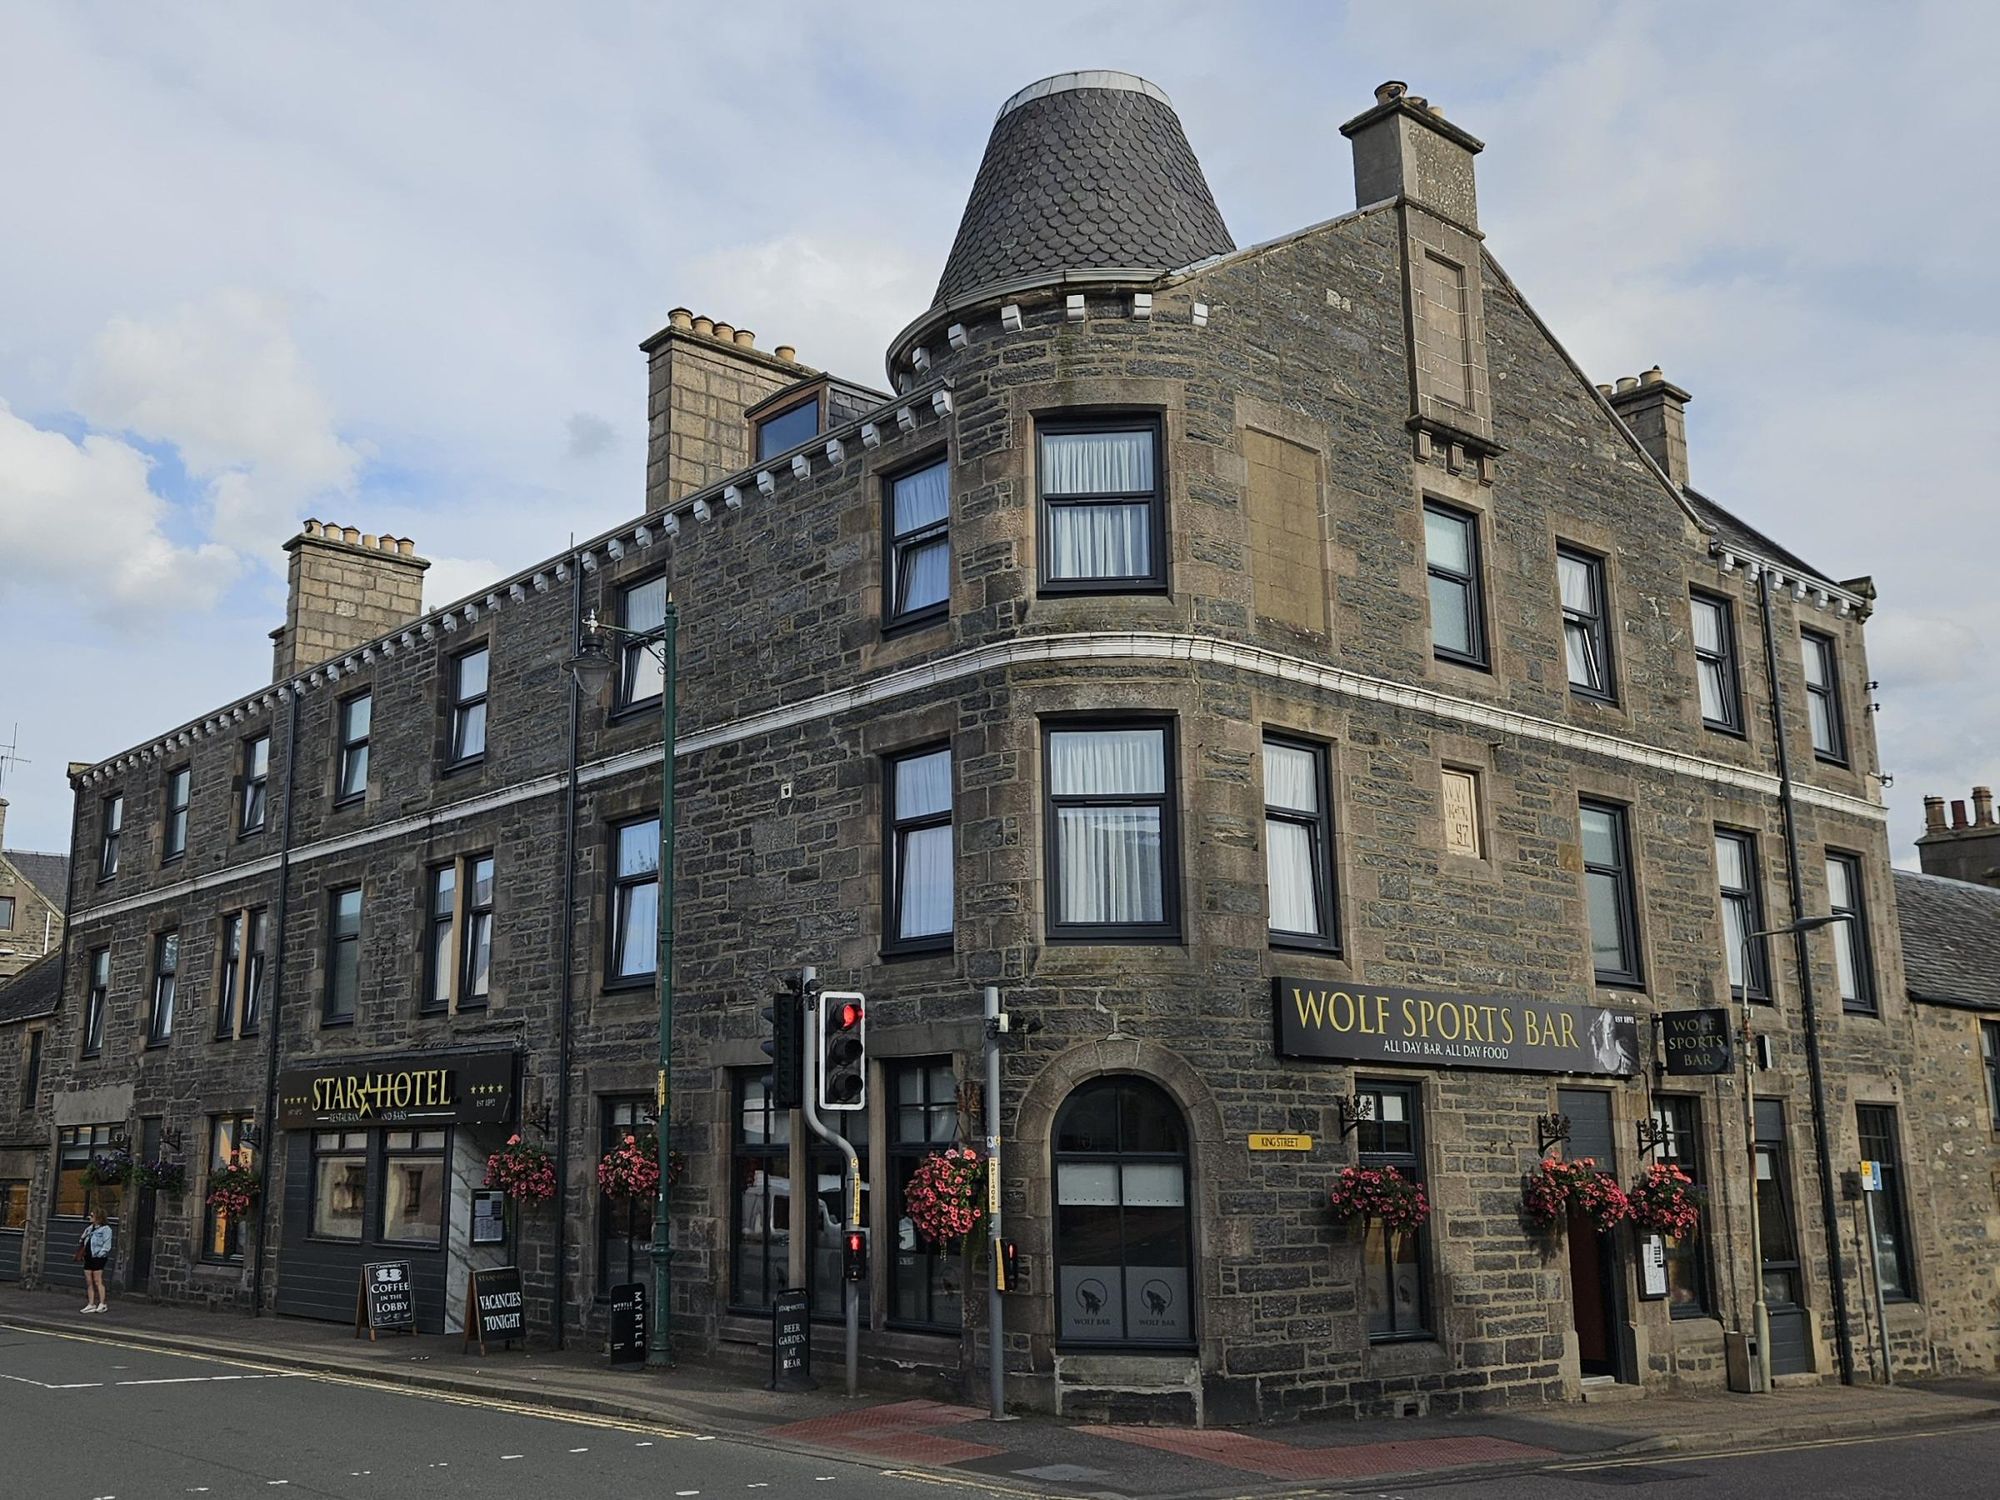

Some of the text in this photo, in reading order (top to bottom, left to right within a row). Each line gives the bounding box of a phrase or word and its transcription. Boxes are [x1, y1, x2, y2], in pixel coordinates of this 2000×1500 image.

[1292, 988, 1580, 1048] WOLF SPORTS BAR
[1672, 1018, 1715, 1032] WOLF
[1668, 1035, 1724, 1050] SPORTS
[1384, 1039, 1400, 1053] ALL
[1402, 1040, 1421, 1054] DAY
[1445, 1044, 1461, 1057] ALL
[1463, 1046, 1481, 1058] DAY
[1483, 1046, 1509, 1060] FOOD
[1683, 1053, 1713, 1066] BAR
[312, 1069, 451, 1111] STAR HOTEL
[1261, 1137, 1298, 1147] KING STREET
[371, 1282, 410, 1294] COFFEE
[479, 1291, 522, 1310] VACANCIES
[376, 1301, 409, 1313] LOBBY
[484, 1312, 521, 1332] TONIGHT
[634, 1291, 643, 1348] MYRTLE
[1073, 1318, 1111, 1326] WOLF BAR
[1138, 1319, 1159, 1327] WOLF
[783, 1323, 801, 1334] BEER
[778, 1334, 806, 1346] GARDEN
[788, 1347, 797, 1358] AT
[783, 1358, 802, 1369] REAR
